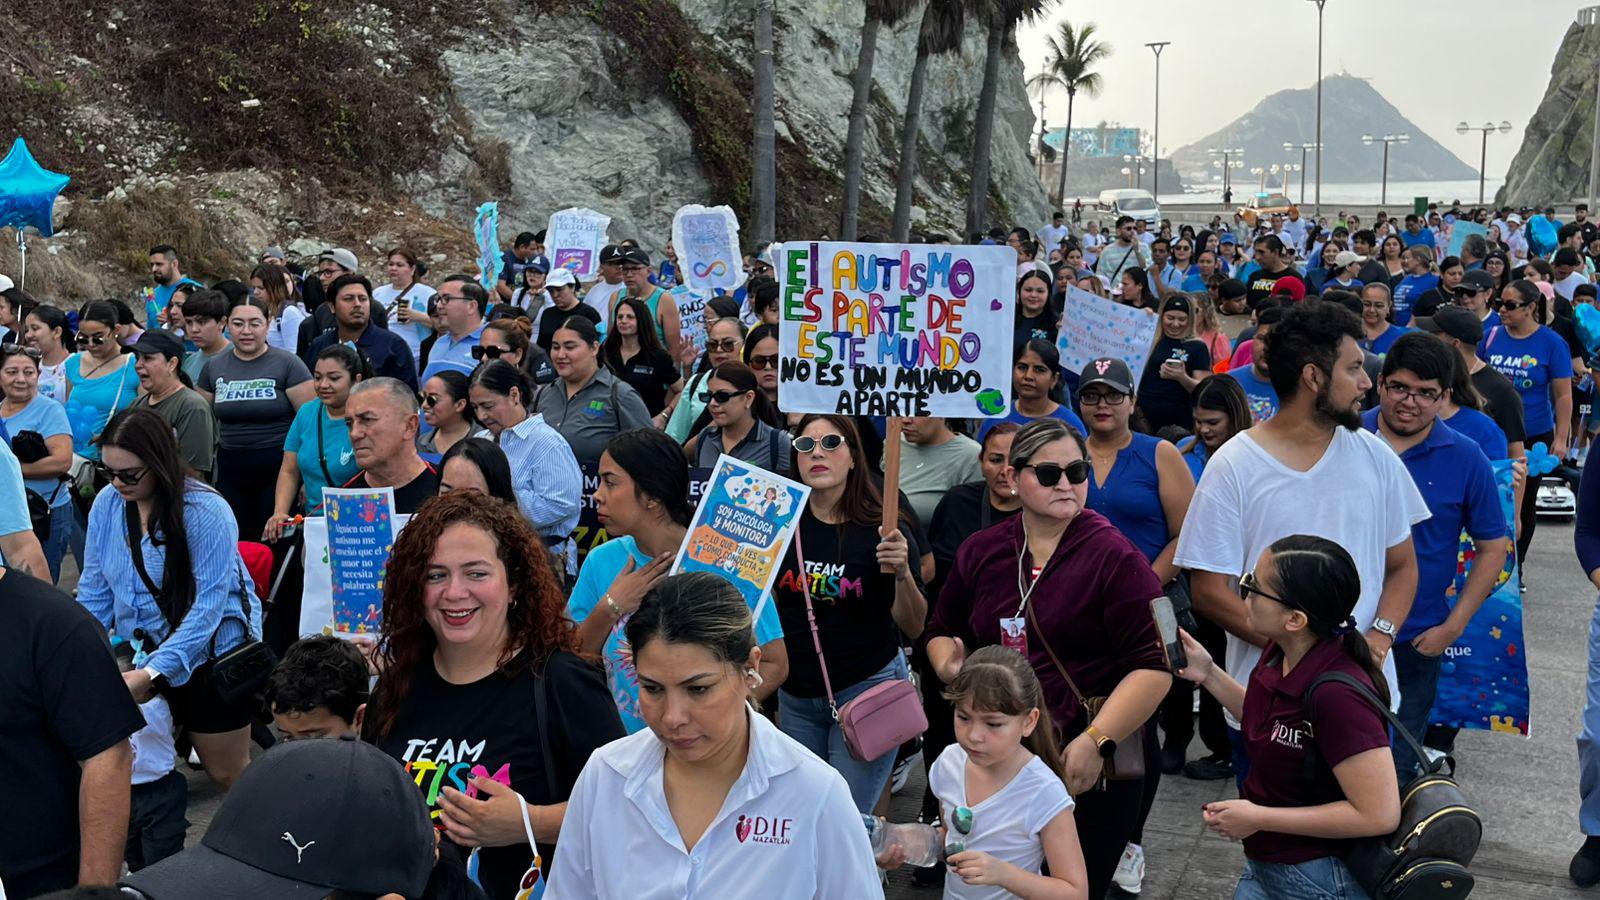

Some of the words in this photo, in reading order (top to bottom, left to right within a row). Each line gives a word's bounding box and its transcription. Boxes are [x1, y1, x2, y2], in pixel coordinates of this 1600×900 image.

[832, 249, 974, 298] AUTISMO
[784, 285, 824, 323] ES
[832, 291, 917, 337] PARTE
[927, 294, 966, 334] DE
[798, 324, 867, 369] ESTE
[878, 329, 981, 372] MUNDO
[781, 356, 811, 383] NO
[815, 361, 844, 386] ES
[853, 366, 887, 391] UN
[895, 366, 982, 394] MUNDO
[226, 388, 274, 400] ENEES
[835, 389, 931, 417] APARTE
[1579, 404, 1592, 414] 92
[359, 525, 375, 533] con
[717, 504, 733, 519] SOY
[733, 510, 774, 535] PSICÓLOGA
[362, 537, 375, 545] me
[721, 519, 768, 546] MONITORA
[358, 549, 373, 558] que
[375, 546, 382, 555] el
[702, 543, 721, 556] COMO
[722, 549, 758, 572] CONDUCTA
[710, 535, 720, 544] LO
[720, 539, 734, 550] QUE
[745, 548, 758, 559] VES
[342, 569, 373, 578] necesita
[362, 560, 373, 568] no
[804, 560, 846, 577] TEAM
[343, 580, 376, 590] palabras
[779, 569, 863, 599] AUTISM
[1444, 646, 1472, 659] que
[1278, 724, 1303, 744] DIF
[402, 738, 486, 764] TEAM
[404, 761, 511, 806] TISM
[754, 816, 793, 838] DIF
